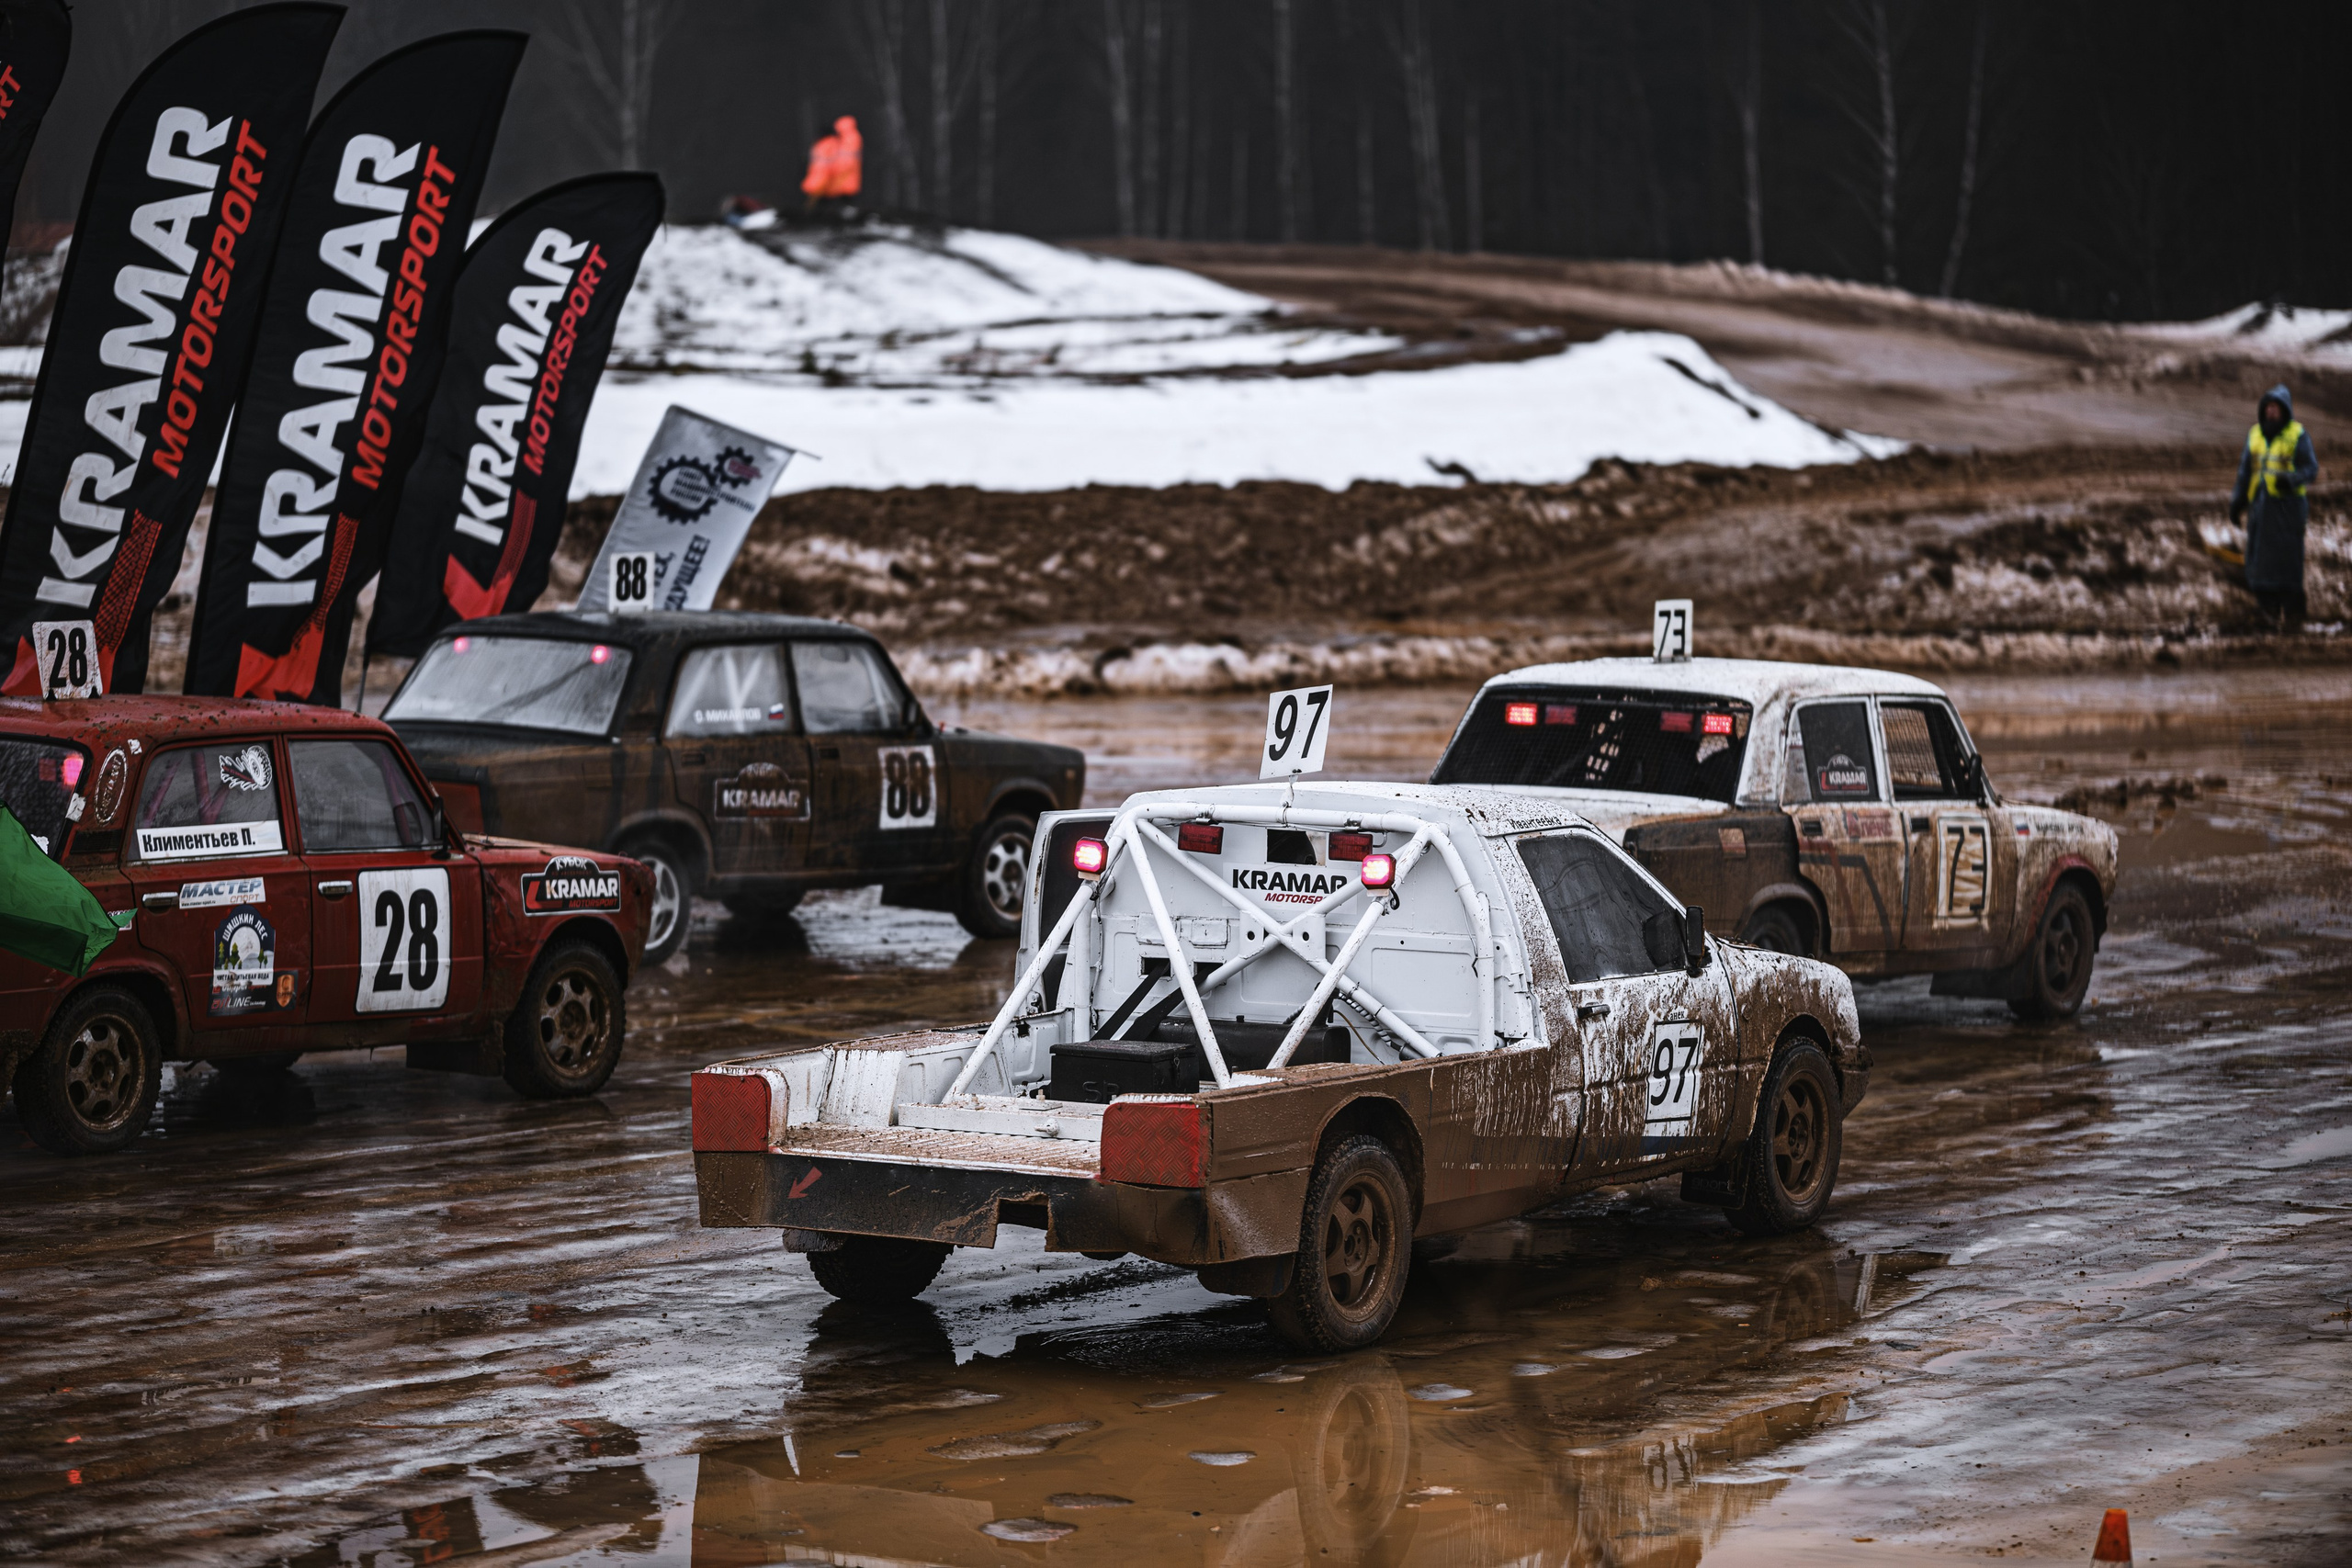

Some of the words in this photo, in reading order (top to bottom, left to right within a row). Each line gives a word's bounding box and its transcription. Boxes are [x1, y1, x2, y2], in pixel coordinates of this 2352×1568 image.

[152, 119, 268, 479] MOTORSPORT
[351, 145, 457, 490] MOTORSPORT
[35, 107, 233, 608] KRAMAR
[247, 133, 422, 607] KRAMAR
[523, 244, 608, 476] MOTORSPORT
[455, 228, 591, 546] KRAMAR
[616, 556, 647, 601] 88
[49, 627, 89, 688] 28
[1657, 608, 1686, 660] 73
[1268, 690, 1329, 761] 97
[723, 789, 800, 808] KRAMAR
[886, 751, 932, 819] 88
[1829, 772, 1867, 784] KRAMAR
[142, 830, 240, 852] Климентьев
[241, 829, 256, 846] П.
[1507, 816, 1562, 829] Ивантеевка
[181, 880, 263, 898] МАСТЕР
[546, 877, 618, 899] KRAMAR
[1232, 869, 1348, 894] KRAMAR
[1947, 825, 1988, 911] 73
[230, 894, 260, 903] СПОРТ
[569, 898, 618, 908] MOTORSPORT
[1264, 892, 1328, 905] MOTORSP
[222, 913, 254, 942] ШИШКИН
[254, 919, 268, 941] ЛЕС
[372, 888, 438, 993] 28
[1668, 1010, 1685, 1021] анек
[1650, 1038, 1699, 1106] 97
